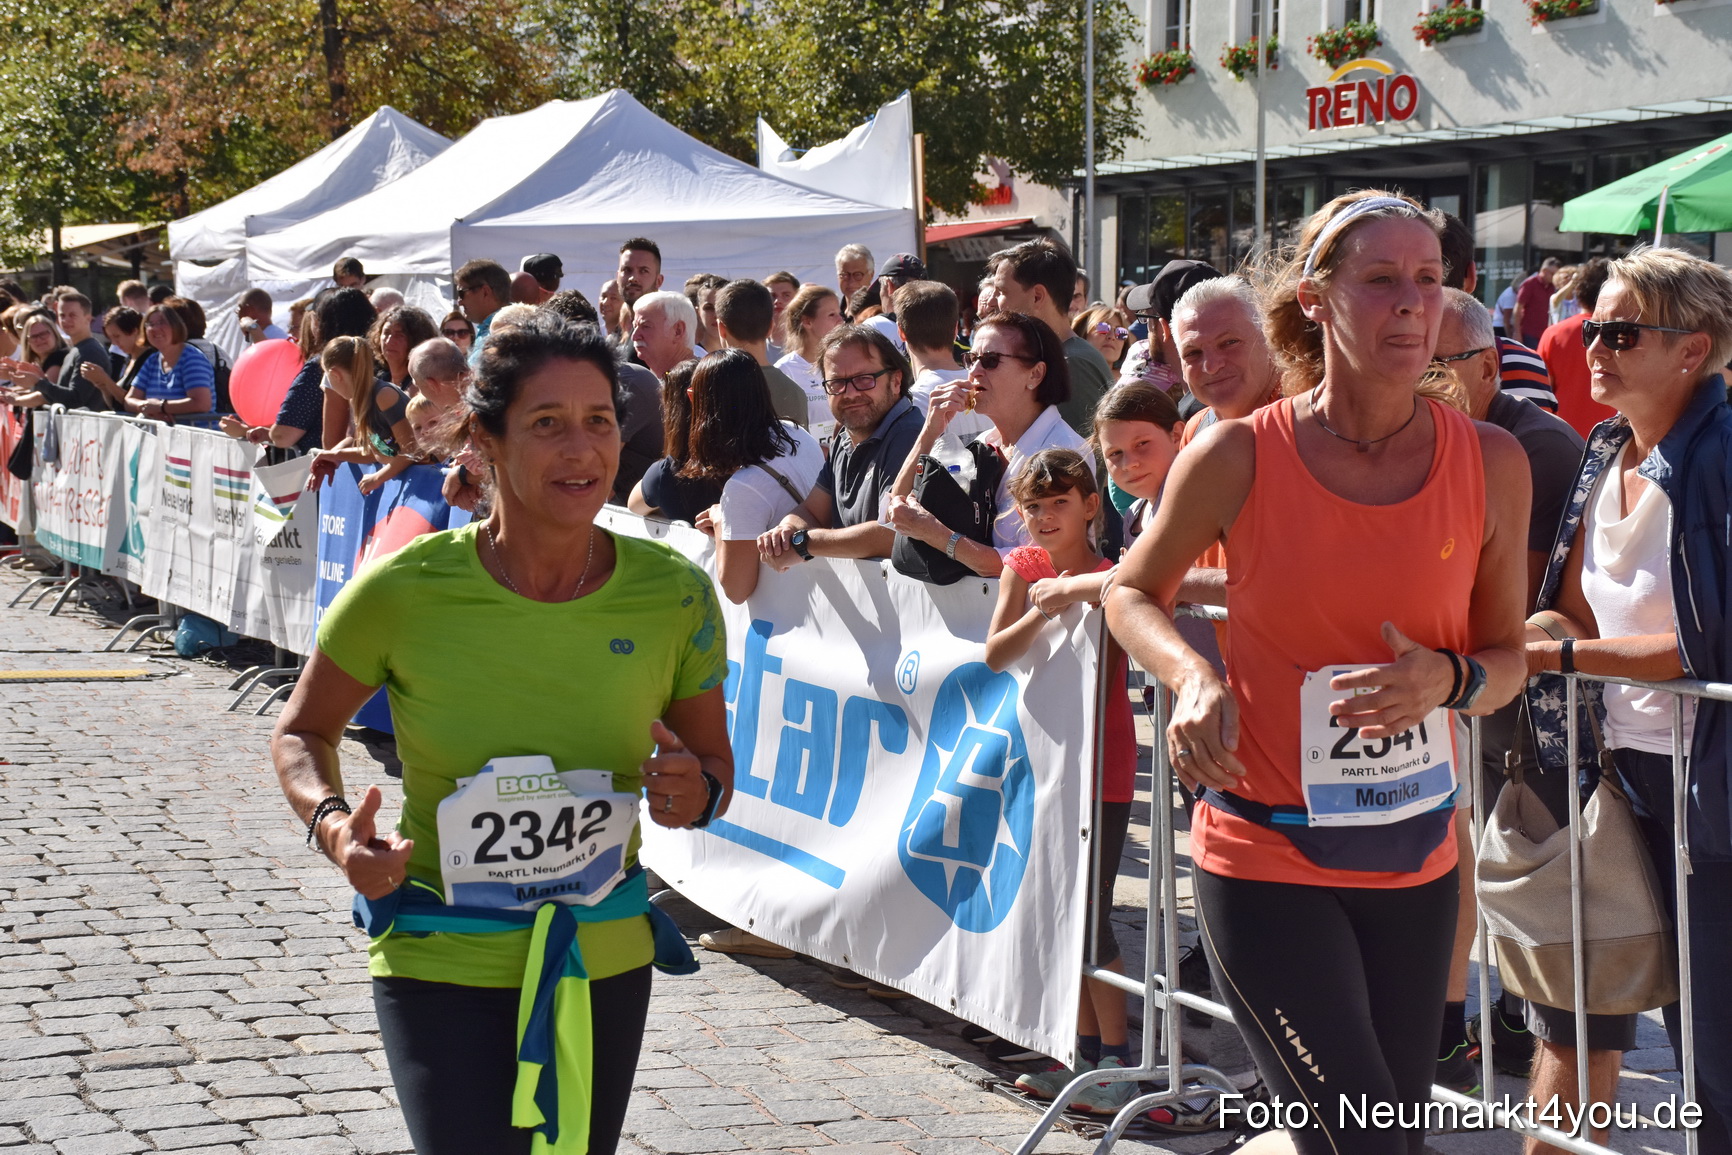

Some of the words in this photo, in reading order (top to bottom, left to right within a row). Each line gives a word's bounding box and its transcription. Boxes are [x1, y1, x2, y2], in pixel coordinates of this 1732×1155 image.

[1306, 75, 1418, 131] RENO
[322, 514, 346, 537] STORE
[1312, 750, 1319, 760] D
[1341, 767, 1378, 777] PARTL
[1381, 757, 1420, 775] Neumarkt
[1356, 781, 1420, 807] Monika
[471, 800, 612, 865] 2342
[453, 855, 461, 865] D
[488, 864, 530, 879] PARTL
[533, 853, 587, 876] Neumarkt
[516, 880, 582, 902] Manu
